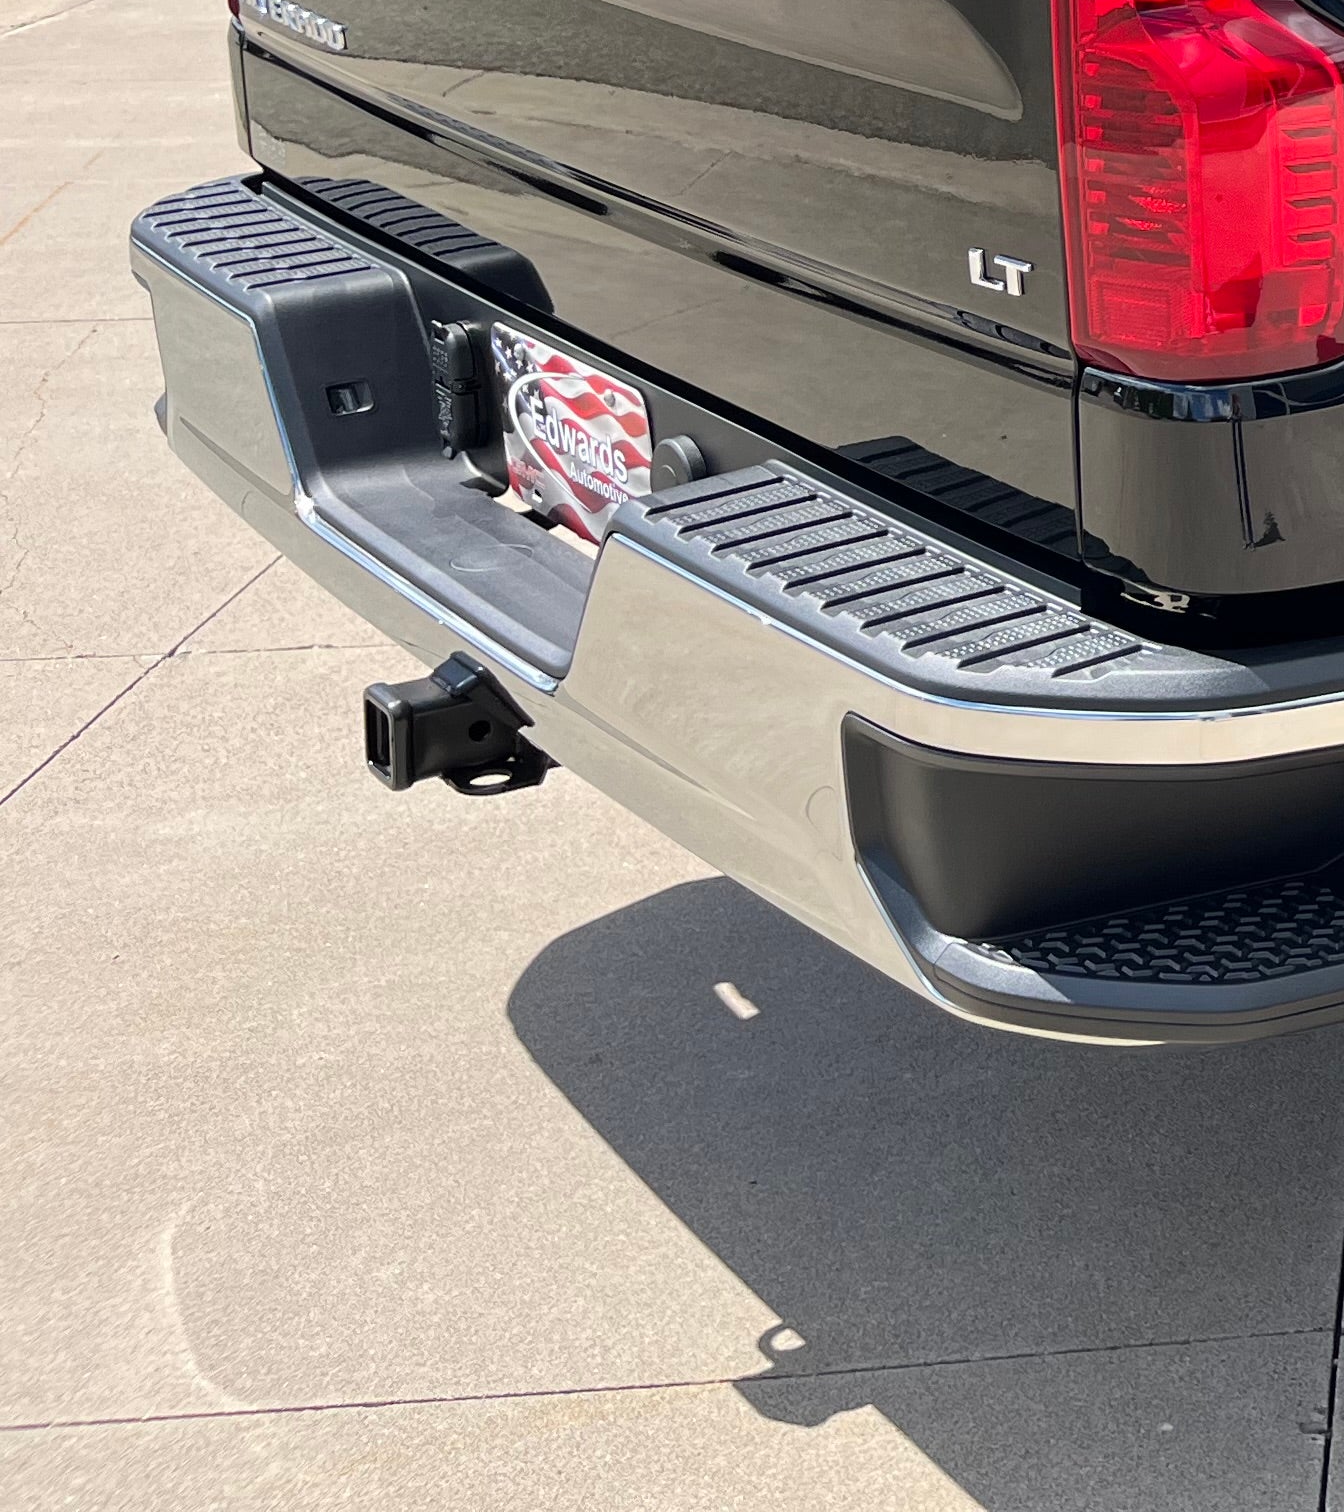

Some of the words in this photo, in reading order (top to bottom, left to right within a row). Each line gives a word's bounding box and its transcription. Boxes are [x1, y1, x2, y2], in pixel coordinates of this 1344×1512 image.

[968, 247, 1033, 296] LT
[530, 395, 628, 485] Edwards
[569, 462, 629, 504] Automotive
